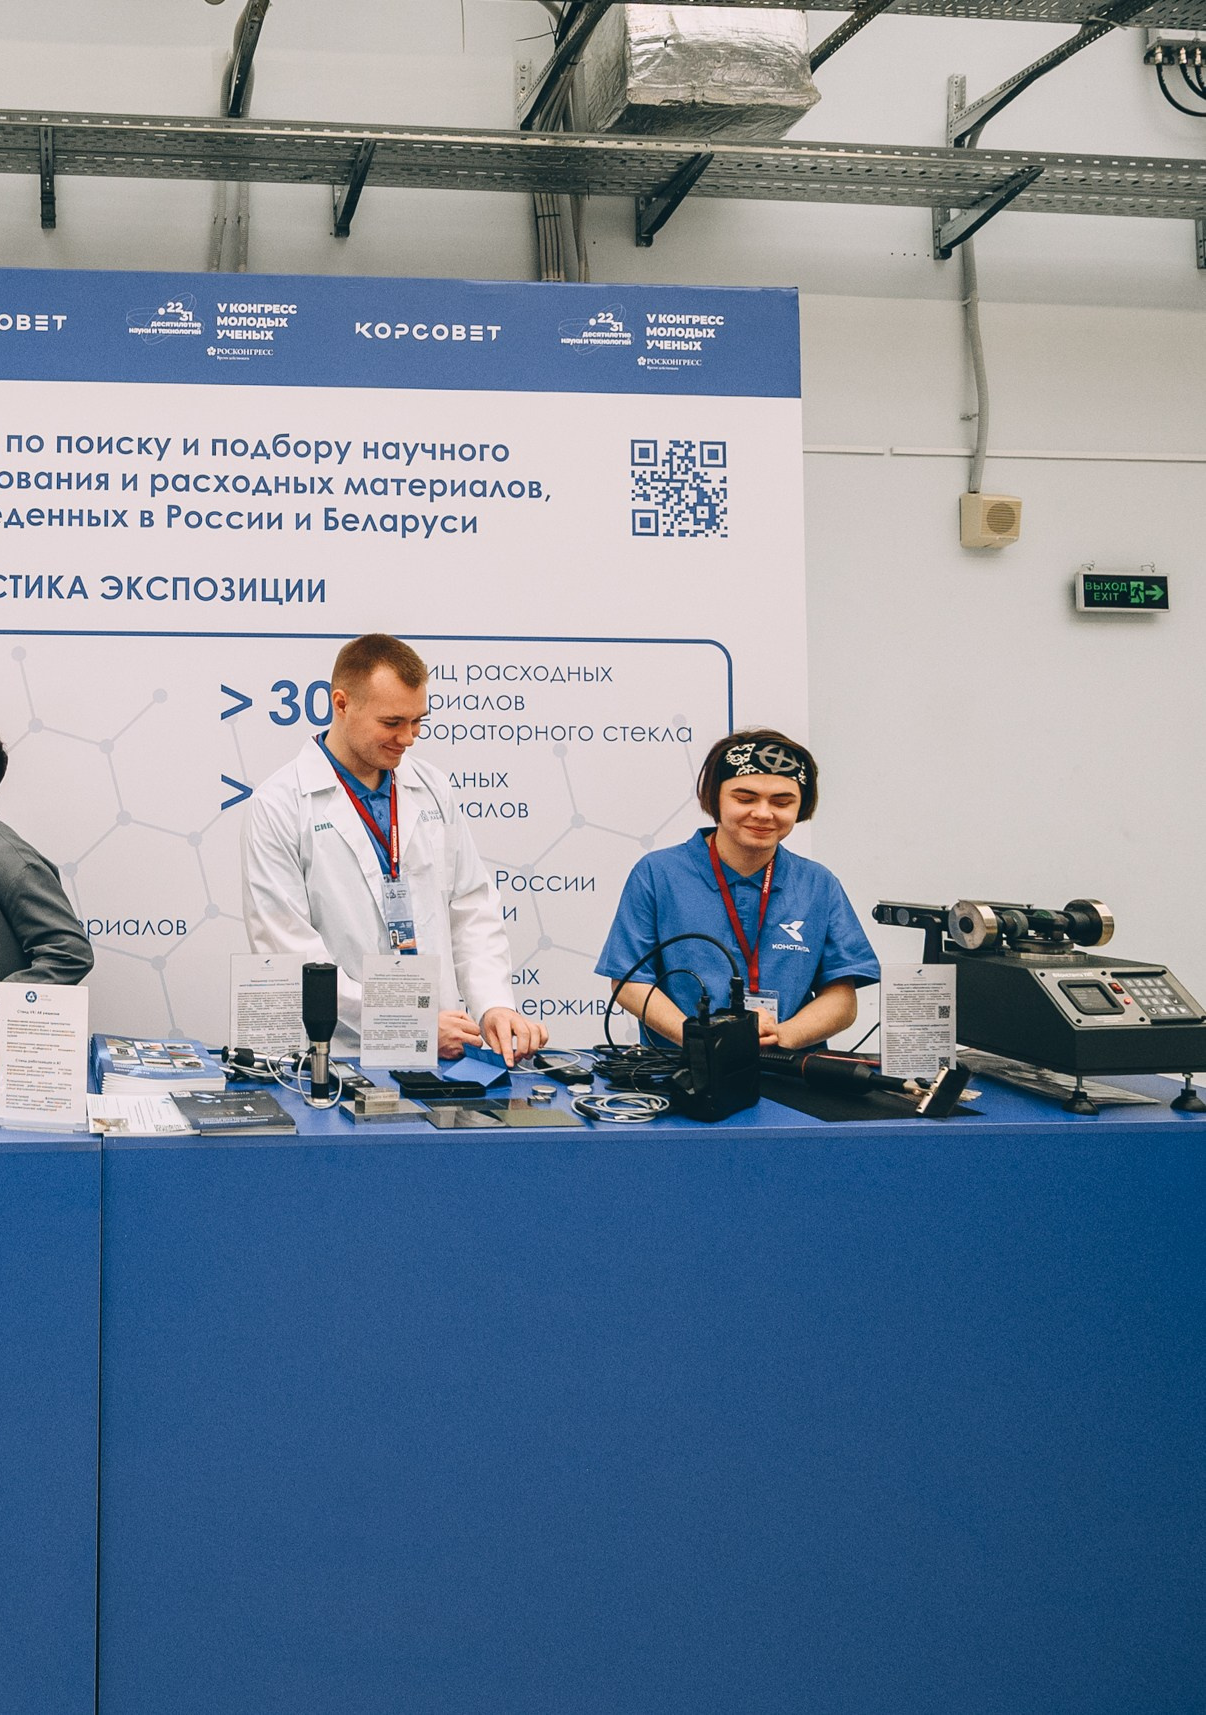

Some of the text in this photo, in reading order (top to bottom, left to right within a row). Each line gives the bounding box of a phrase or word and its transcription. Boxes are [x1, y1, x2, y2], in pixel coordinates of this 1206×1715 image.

[167, 302, 183, 313] 22
[217, 303, 297, 314] V КОНГРЕСС
[179, 311, 192, 321] 31
[216, 316, 288, 328] МОЛОДЫХ
[597, 312, 614, 323] 22
[646, 314, 724, 325] V КОНГРЕСС
[355, 322, 502, 342] КОРСОВЕТ
[610, 322, 623, 332] 31
[646, 327, 715, 339] МОЛОДЫХ
[216, 330, 274, 341] УЧЕНЫХ
[646, 340, 702, 351] УЧЕНЫХ
[216, 348, 274, 356] РОСКОНГРЕСС
[646, 358, 702, 366] РОСКОНГРЕСС
[6, 434, 45, 454] по
[56, 435, 172, 462] поиску
[182, 437, 199, 456] и
[211, 433, 352, 465] подбору
[363, 441, 510, 467] научного
[121, 472, 138, 492] и
[150, 473, 335, 498] расходных
[343, 477, 551, 503] материалов,
[139, 509, 155, 528] в
[167, 504, 283, 530] России
[295, 512, 311, 531] и
[324, 507, 478, 539] Беларуси
[100, 575, 326, 606] ЭКСПОЗИЦИИ
[1085, 582, 1127, 592] ВЫХОД
[466, 664, 613, 686] расходных
[428, 694, 525, 715] риалов
[418, 718, 692, 746] бораторного стекла
[448, 772, 509, 790] дных
[459, 801, 529, 819] алов
[314, 822, 334, 832] СИБ
[495, 870, 595, 892] России
[80, 919, 187, 940] риалов
[511, 968, 540, 985] ых
